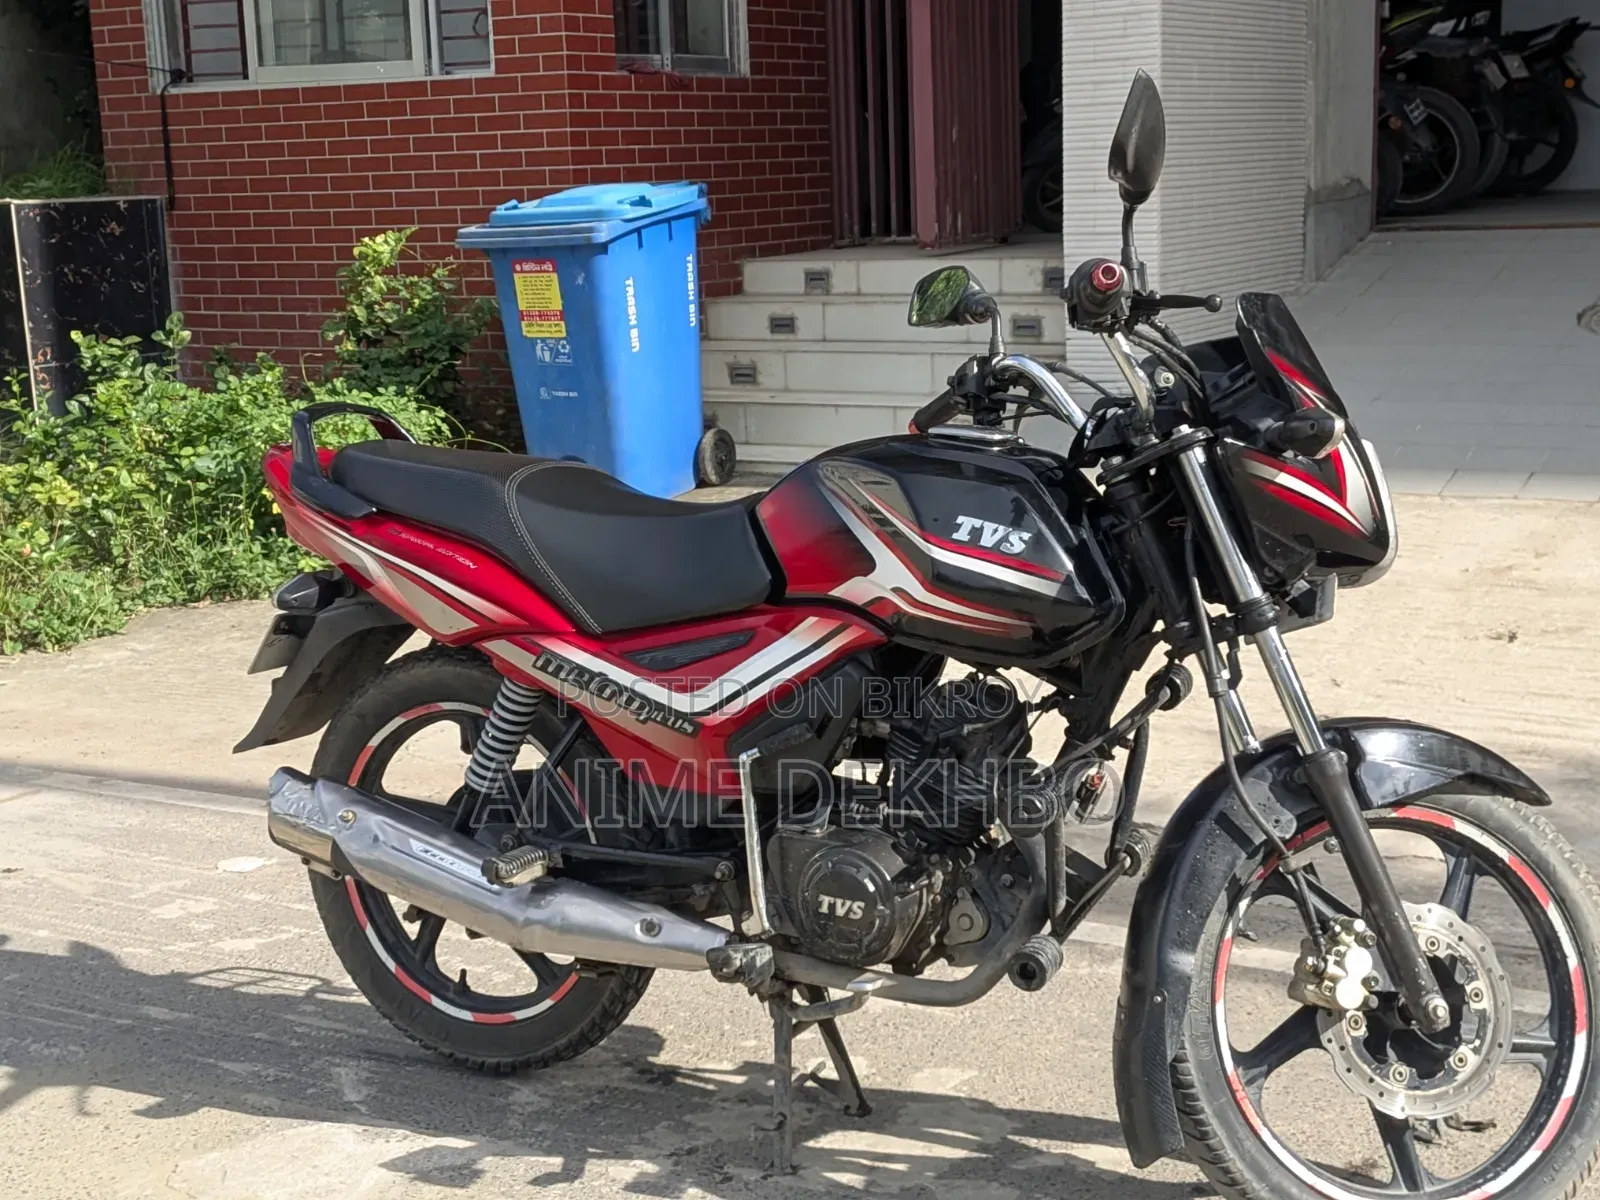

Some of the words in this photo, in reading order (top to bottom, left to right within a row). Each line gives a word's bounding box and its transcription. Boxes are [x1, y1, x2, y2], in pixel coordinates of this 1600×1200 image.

[625, 276, 638, 326] TRASH
[951, 515, 1032, 555] TVS
[818, 894, 866, 920] TVS
